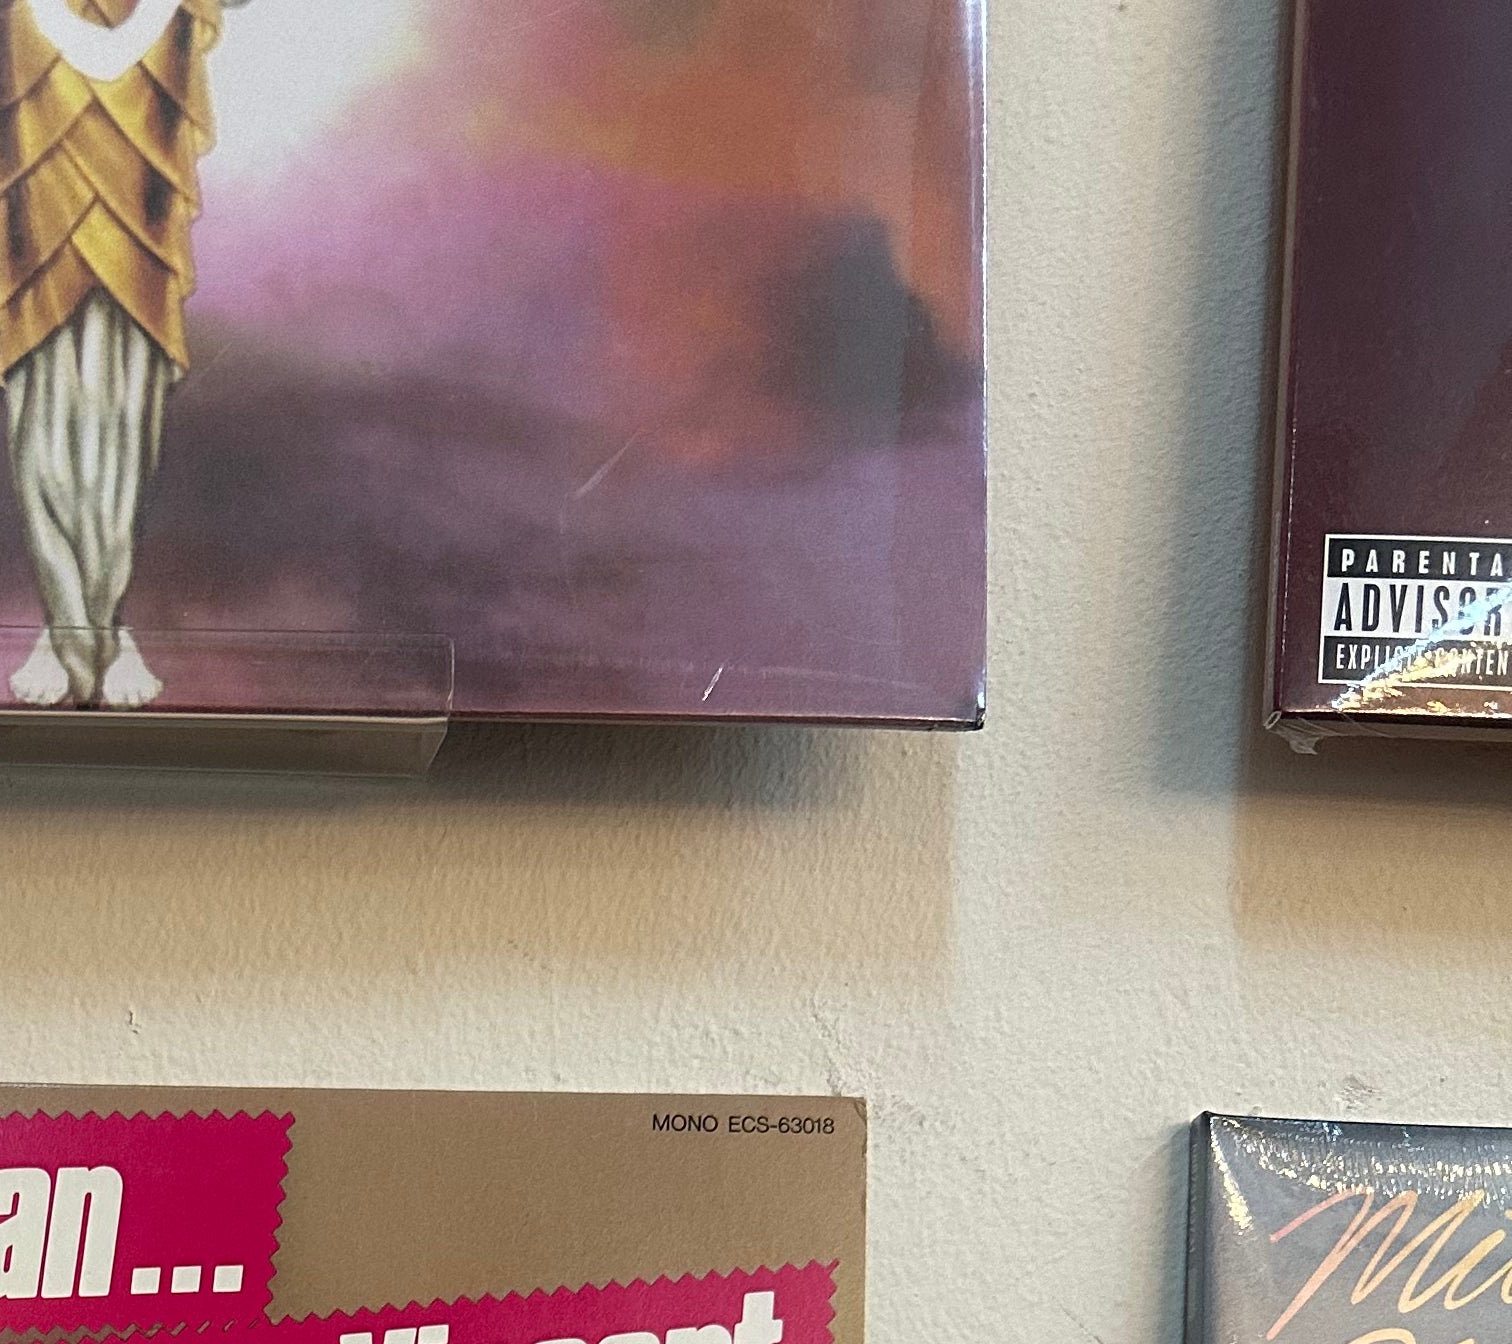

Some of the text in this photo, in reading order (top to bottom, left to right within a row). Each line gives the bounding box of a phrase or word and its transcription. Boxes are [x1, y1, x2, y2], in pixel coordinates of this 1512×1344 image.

[1340, 548, 1504, 577] PARENTA
[651, 1113, 836, 1135] MONO ECS-63018
